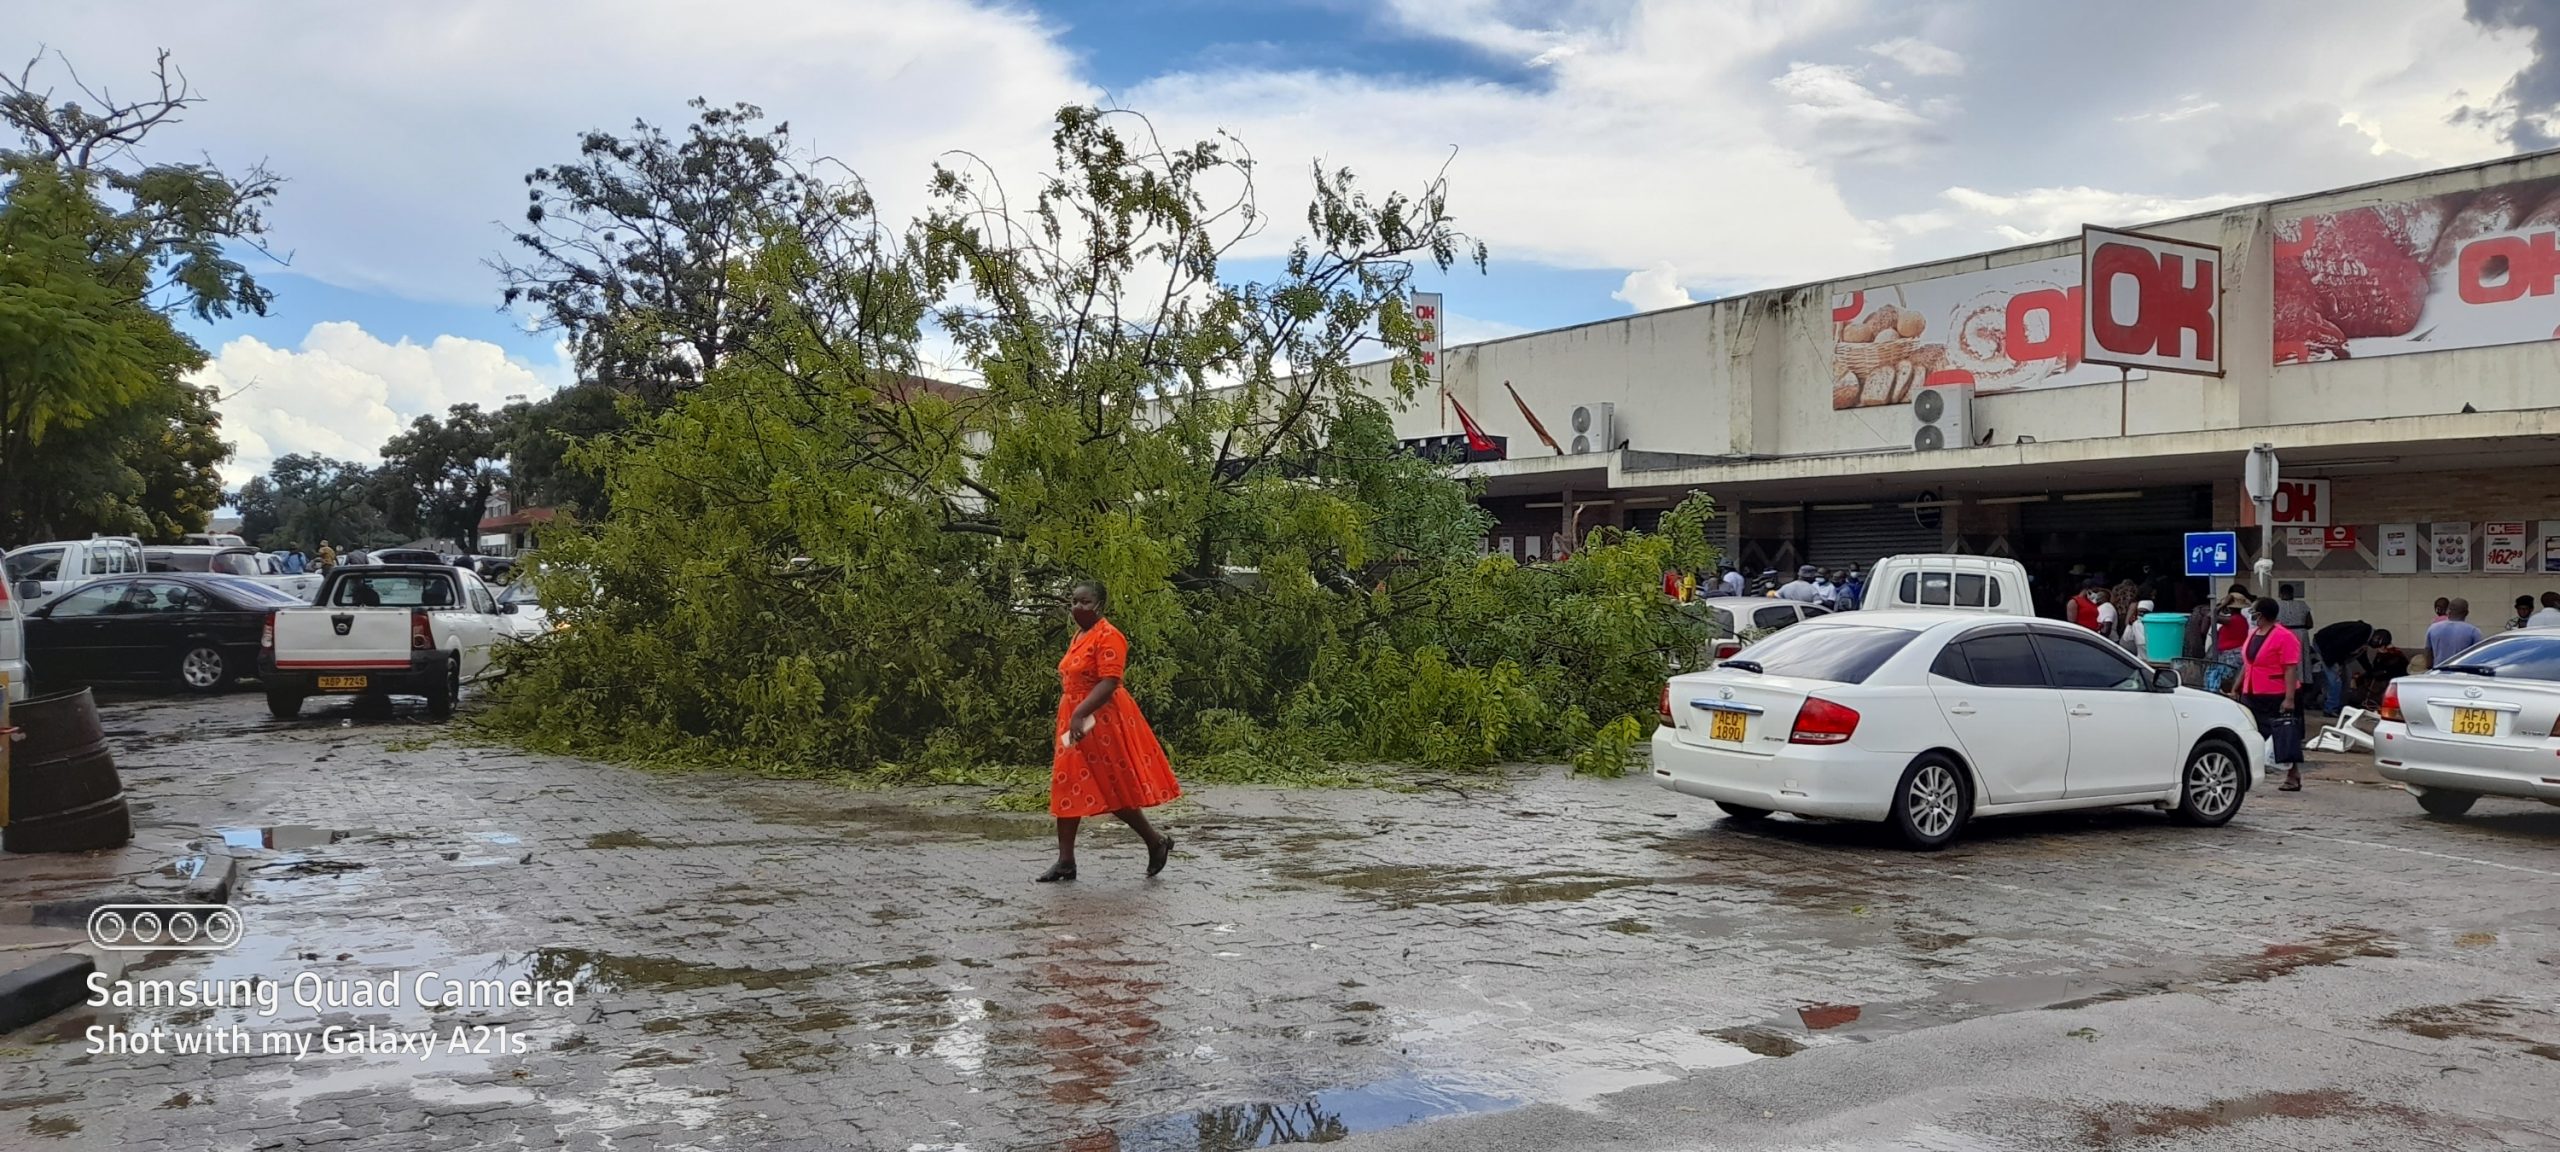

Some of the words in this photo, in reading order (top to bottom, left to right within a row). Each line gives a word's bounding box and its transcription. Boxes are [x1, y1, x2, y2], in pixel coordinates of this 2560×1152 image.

[2091, 242, 2214, 362] OK
[1416, 306, 1435, 319] OK
[2005, 285, 2083, 371] O
[2272, 482, 2317, 523] OK
[2487, 524, 2505, 534] OK
[2463, 709, 2488, 722] AFA
[1716, 726, 1741, 740] 1890
[2459, 721, 2491, 736] 1919
